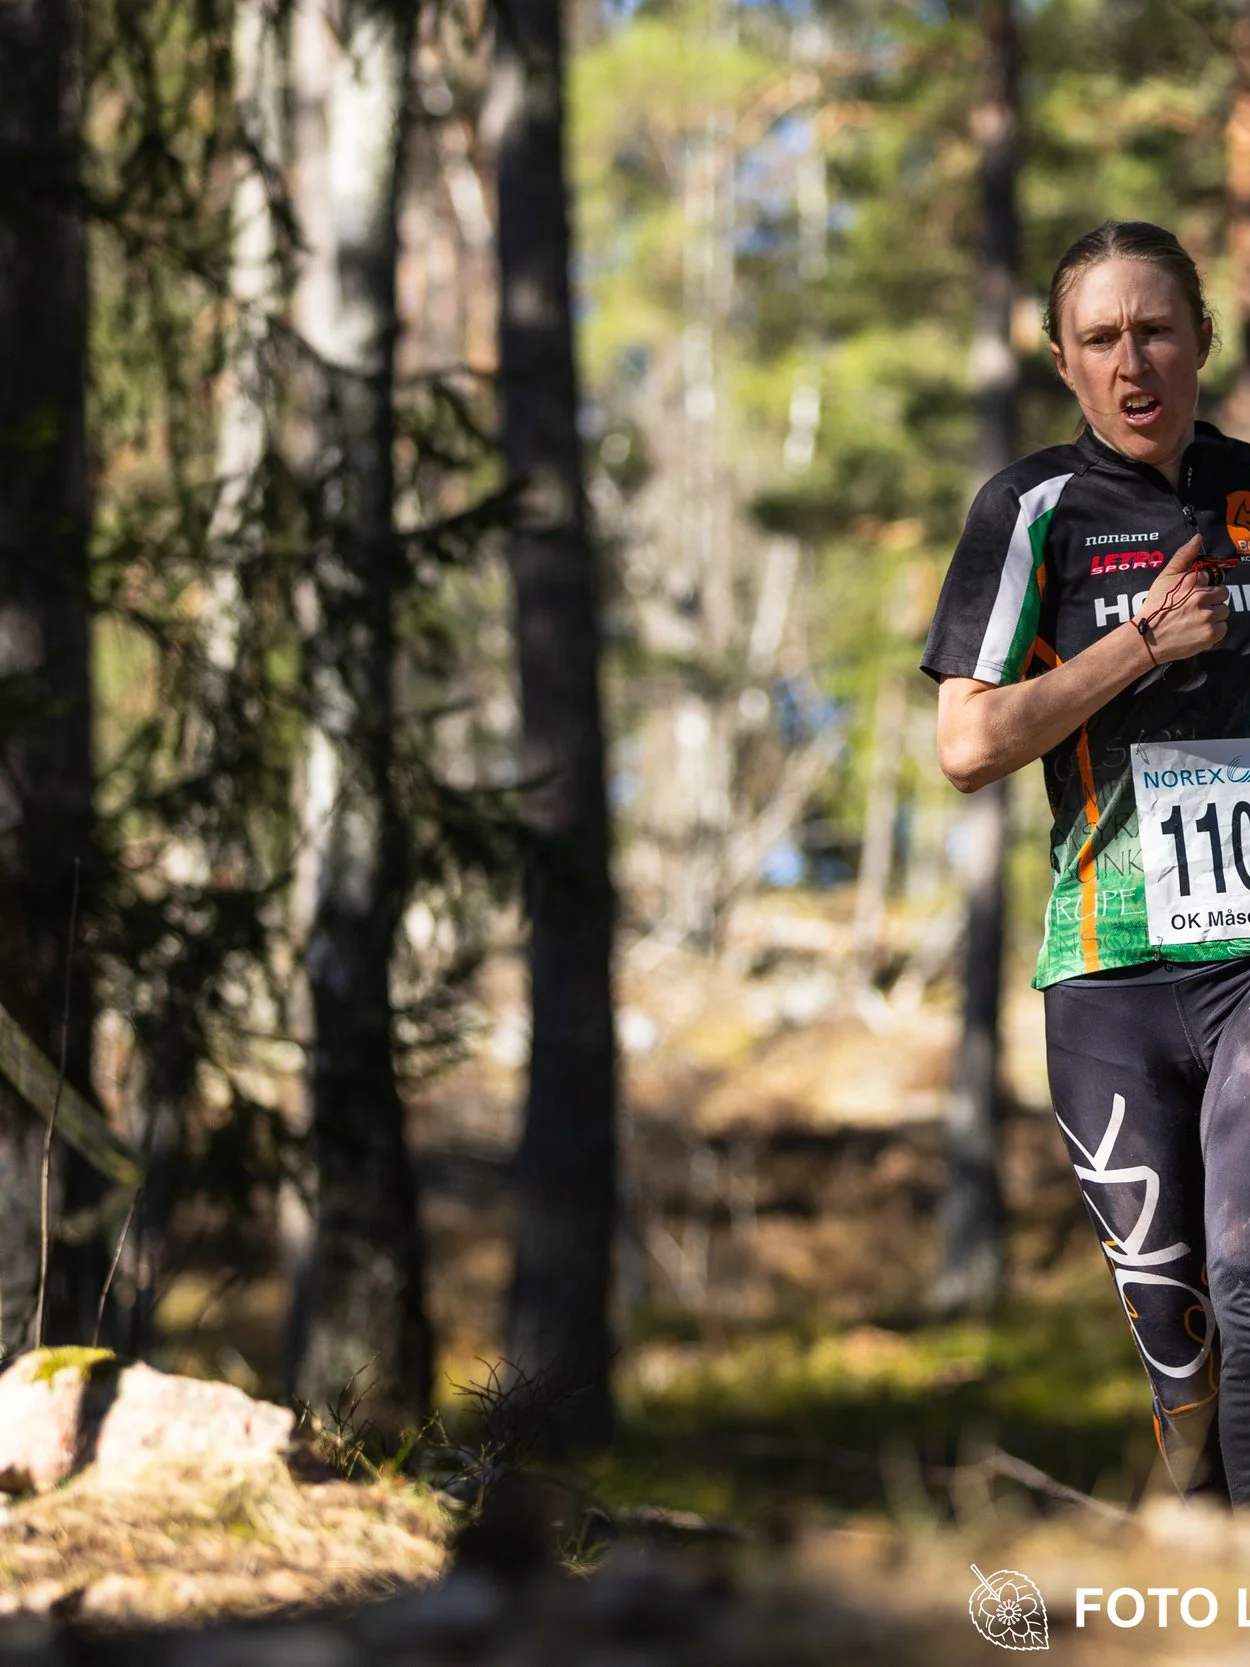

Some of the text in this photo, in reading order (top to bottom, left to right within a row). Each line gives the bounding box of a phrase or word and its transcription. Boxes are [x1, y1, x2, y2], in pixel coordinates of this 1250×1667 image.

[1085, 532, 1160, 546] noname
[1090, 561, 1164, 576] SPORT
[1144, 768, 1225, 789] NOREX
[1171, 912, 1202, 931] OK
